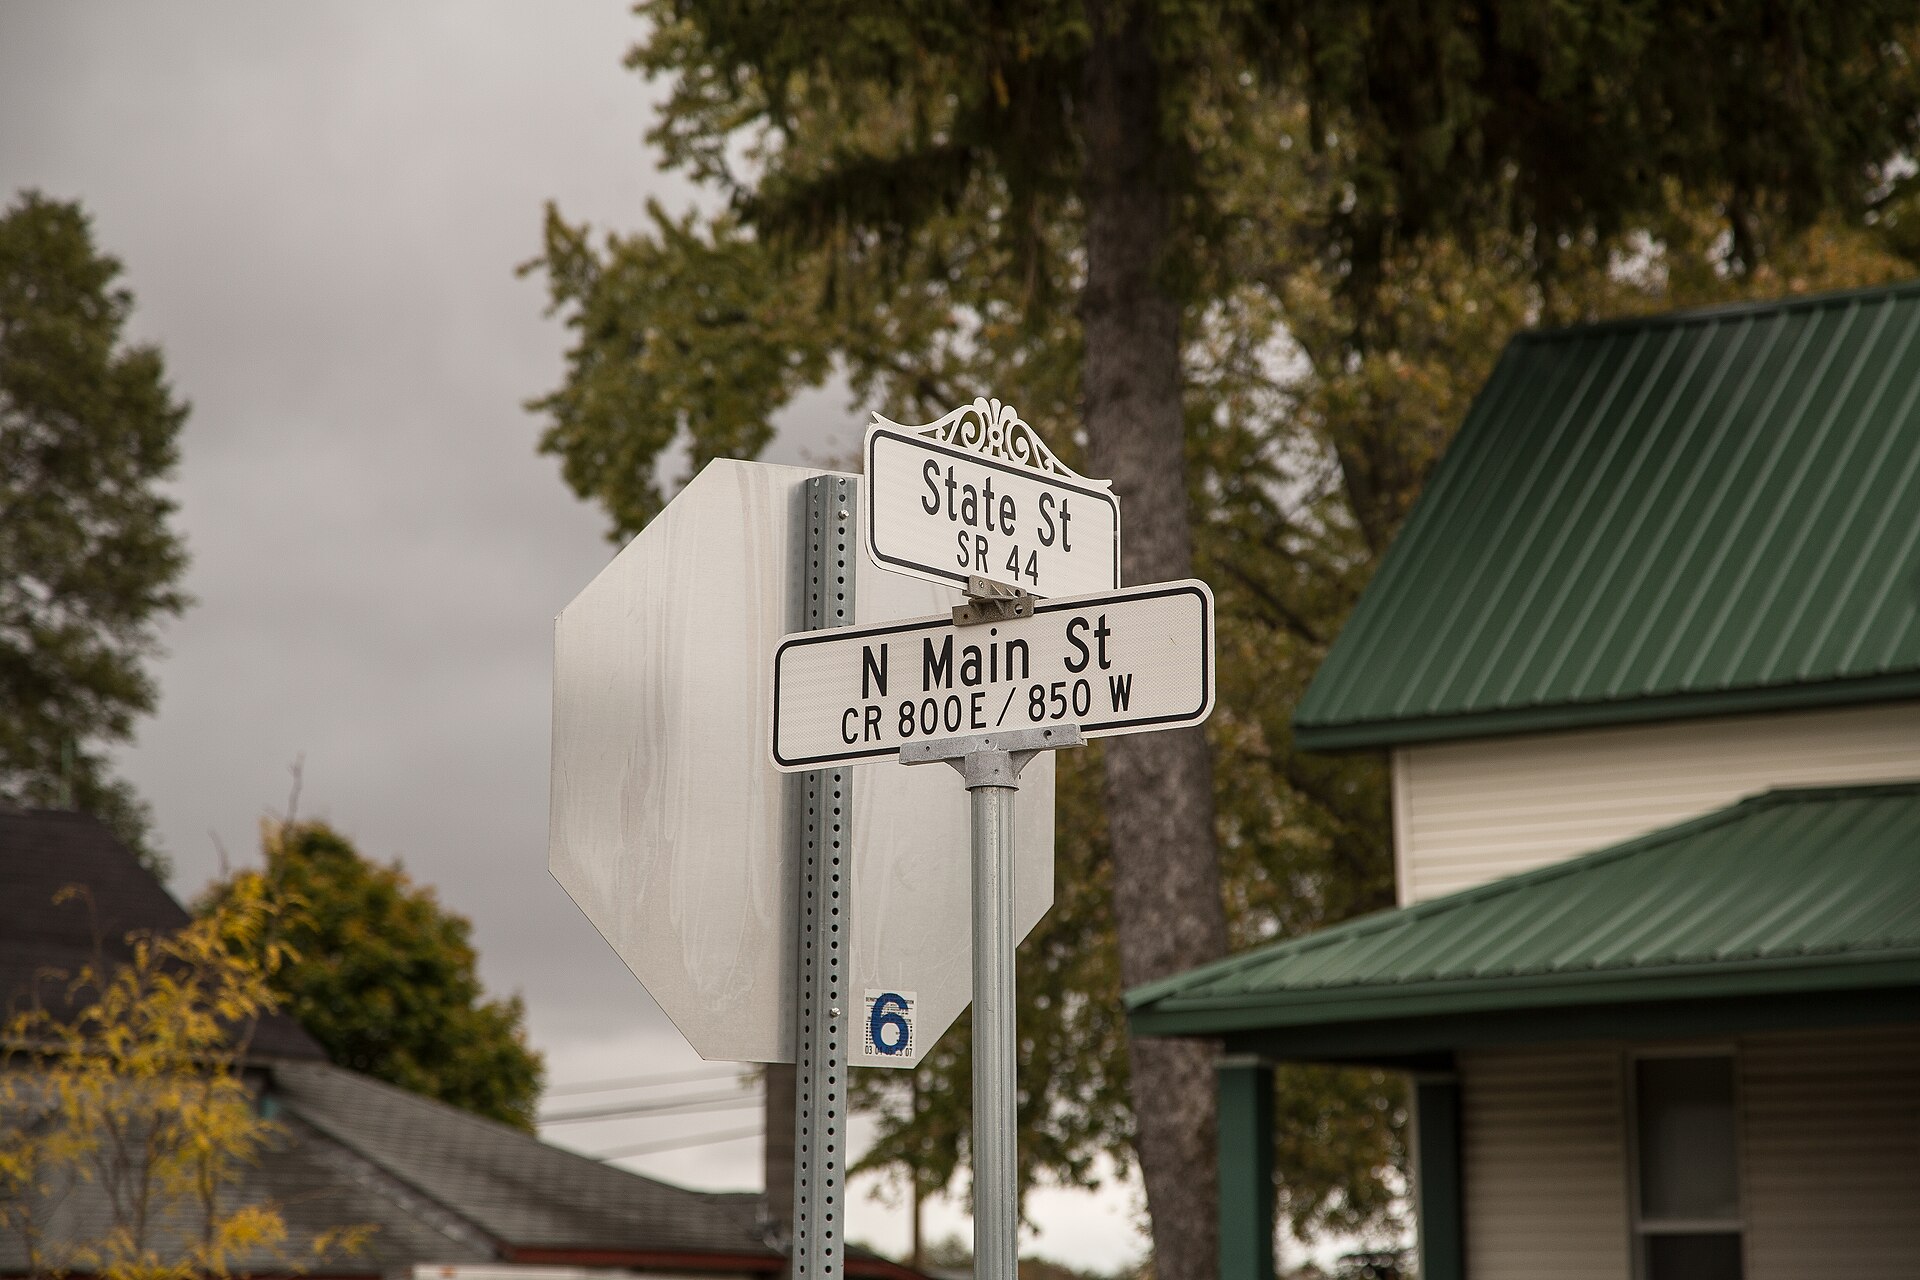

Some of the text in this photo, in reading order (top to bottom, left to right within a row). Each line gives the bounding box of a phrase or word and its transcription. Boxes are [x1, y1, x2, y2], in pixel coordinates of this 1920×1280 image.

[921, 459, 1072, 552] State St
[956, 530, 1039, 586] SR 44
[862, 613, 1112, 699] N Main St
[841, 705, 882, 744] CR
[1028, 678, 1091, 722] 850
[1108, 673, 1133, 713] W
[870, 993, 909, 1055] 6
